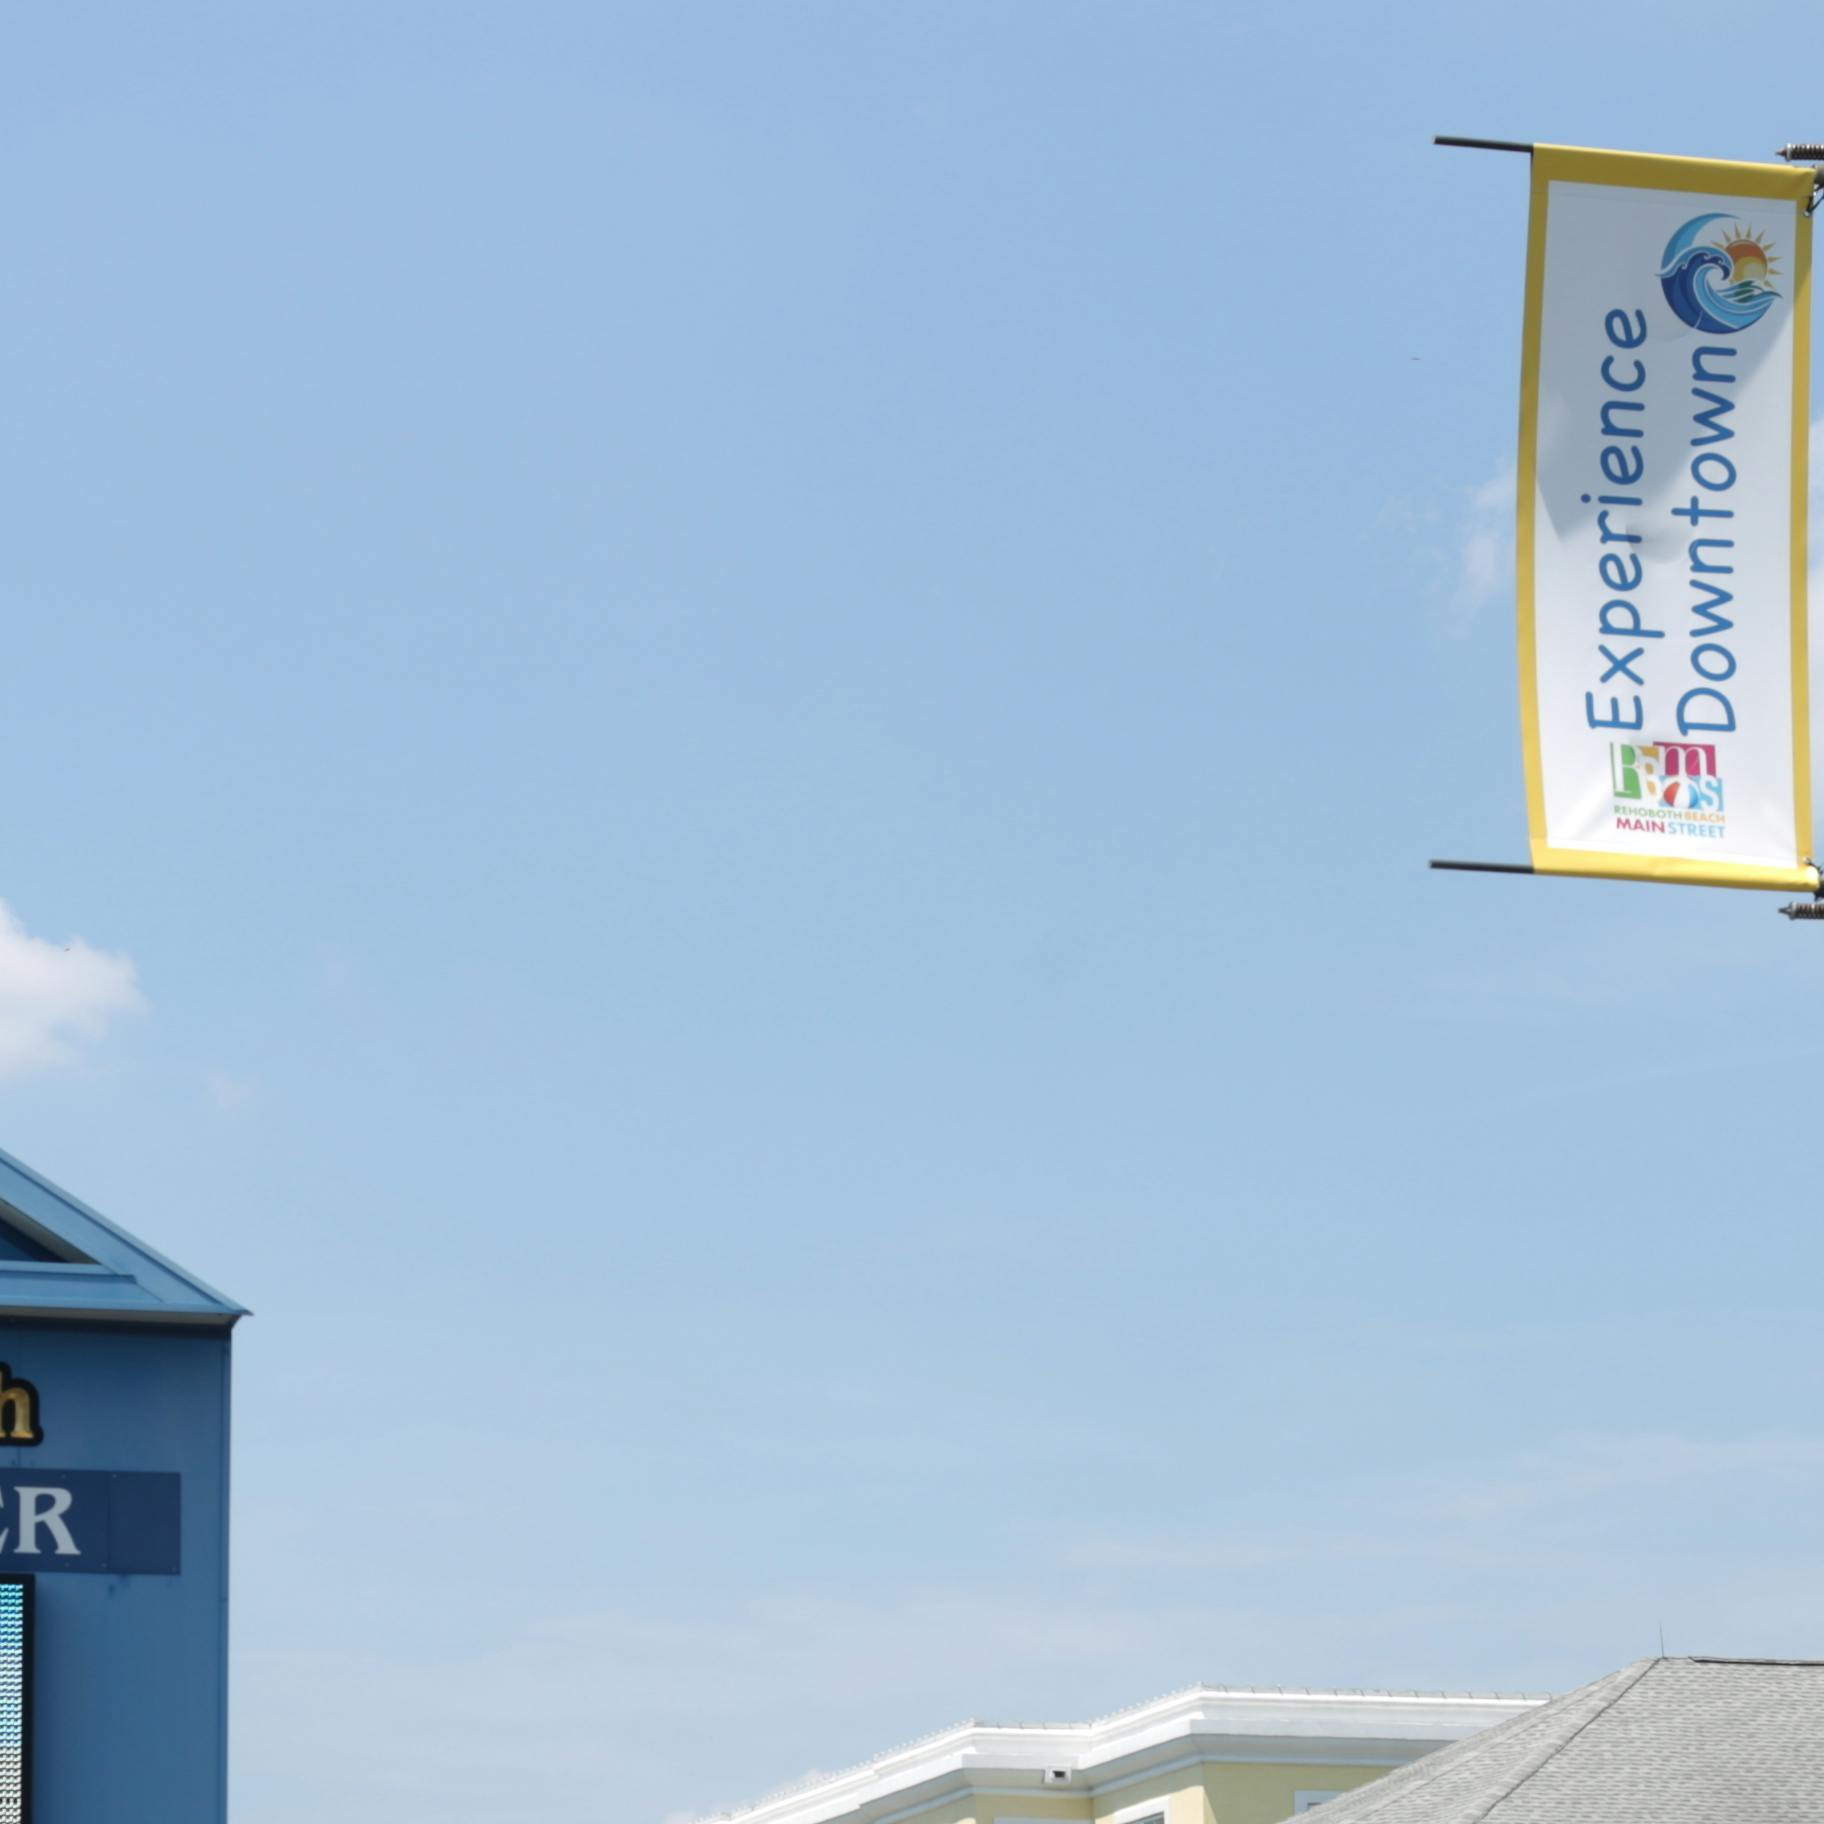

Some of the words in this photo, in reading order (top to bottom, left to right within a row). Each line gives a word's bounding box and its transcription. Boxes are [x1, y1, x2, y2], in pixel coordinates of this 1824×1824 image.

[1581, 308, 1665, 731] Experience
[1671, 345, 1737, 737] Downtown
[1614, 805, 1683, 820] REHOBOTH
[1684, 811, 1726, 824] BEACH
[1616, 817, 1666, 834] MAIN
[1668, 821, 1726, 839] STREET
